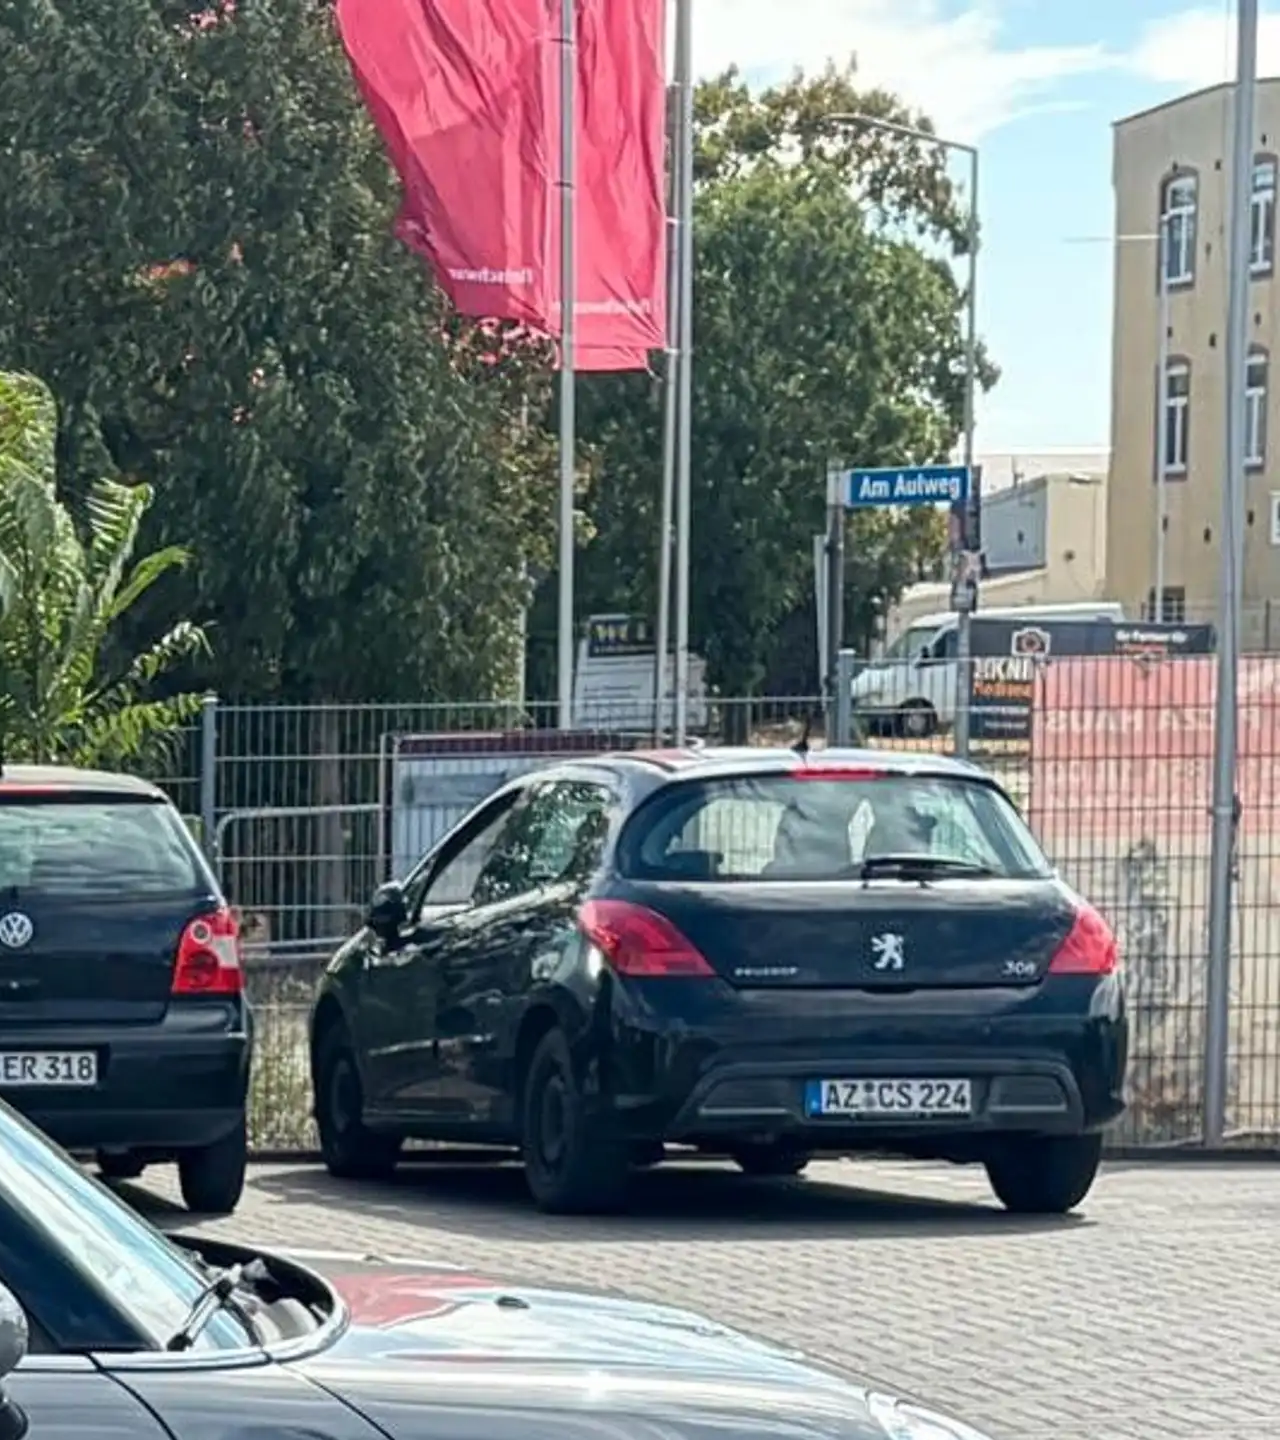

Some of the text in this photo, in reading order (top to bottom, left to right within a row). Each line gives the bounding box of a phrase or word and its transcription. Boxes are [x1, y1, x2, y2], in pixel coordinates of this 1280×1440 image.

[859, 472, 961, 500] Am Aulweg
[3, 1055, 37, 1081] ER
[43, 1055, 95, 1081] 318
[825, 1081, 968, 1109] AZ CS 224
